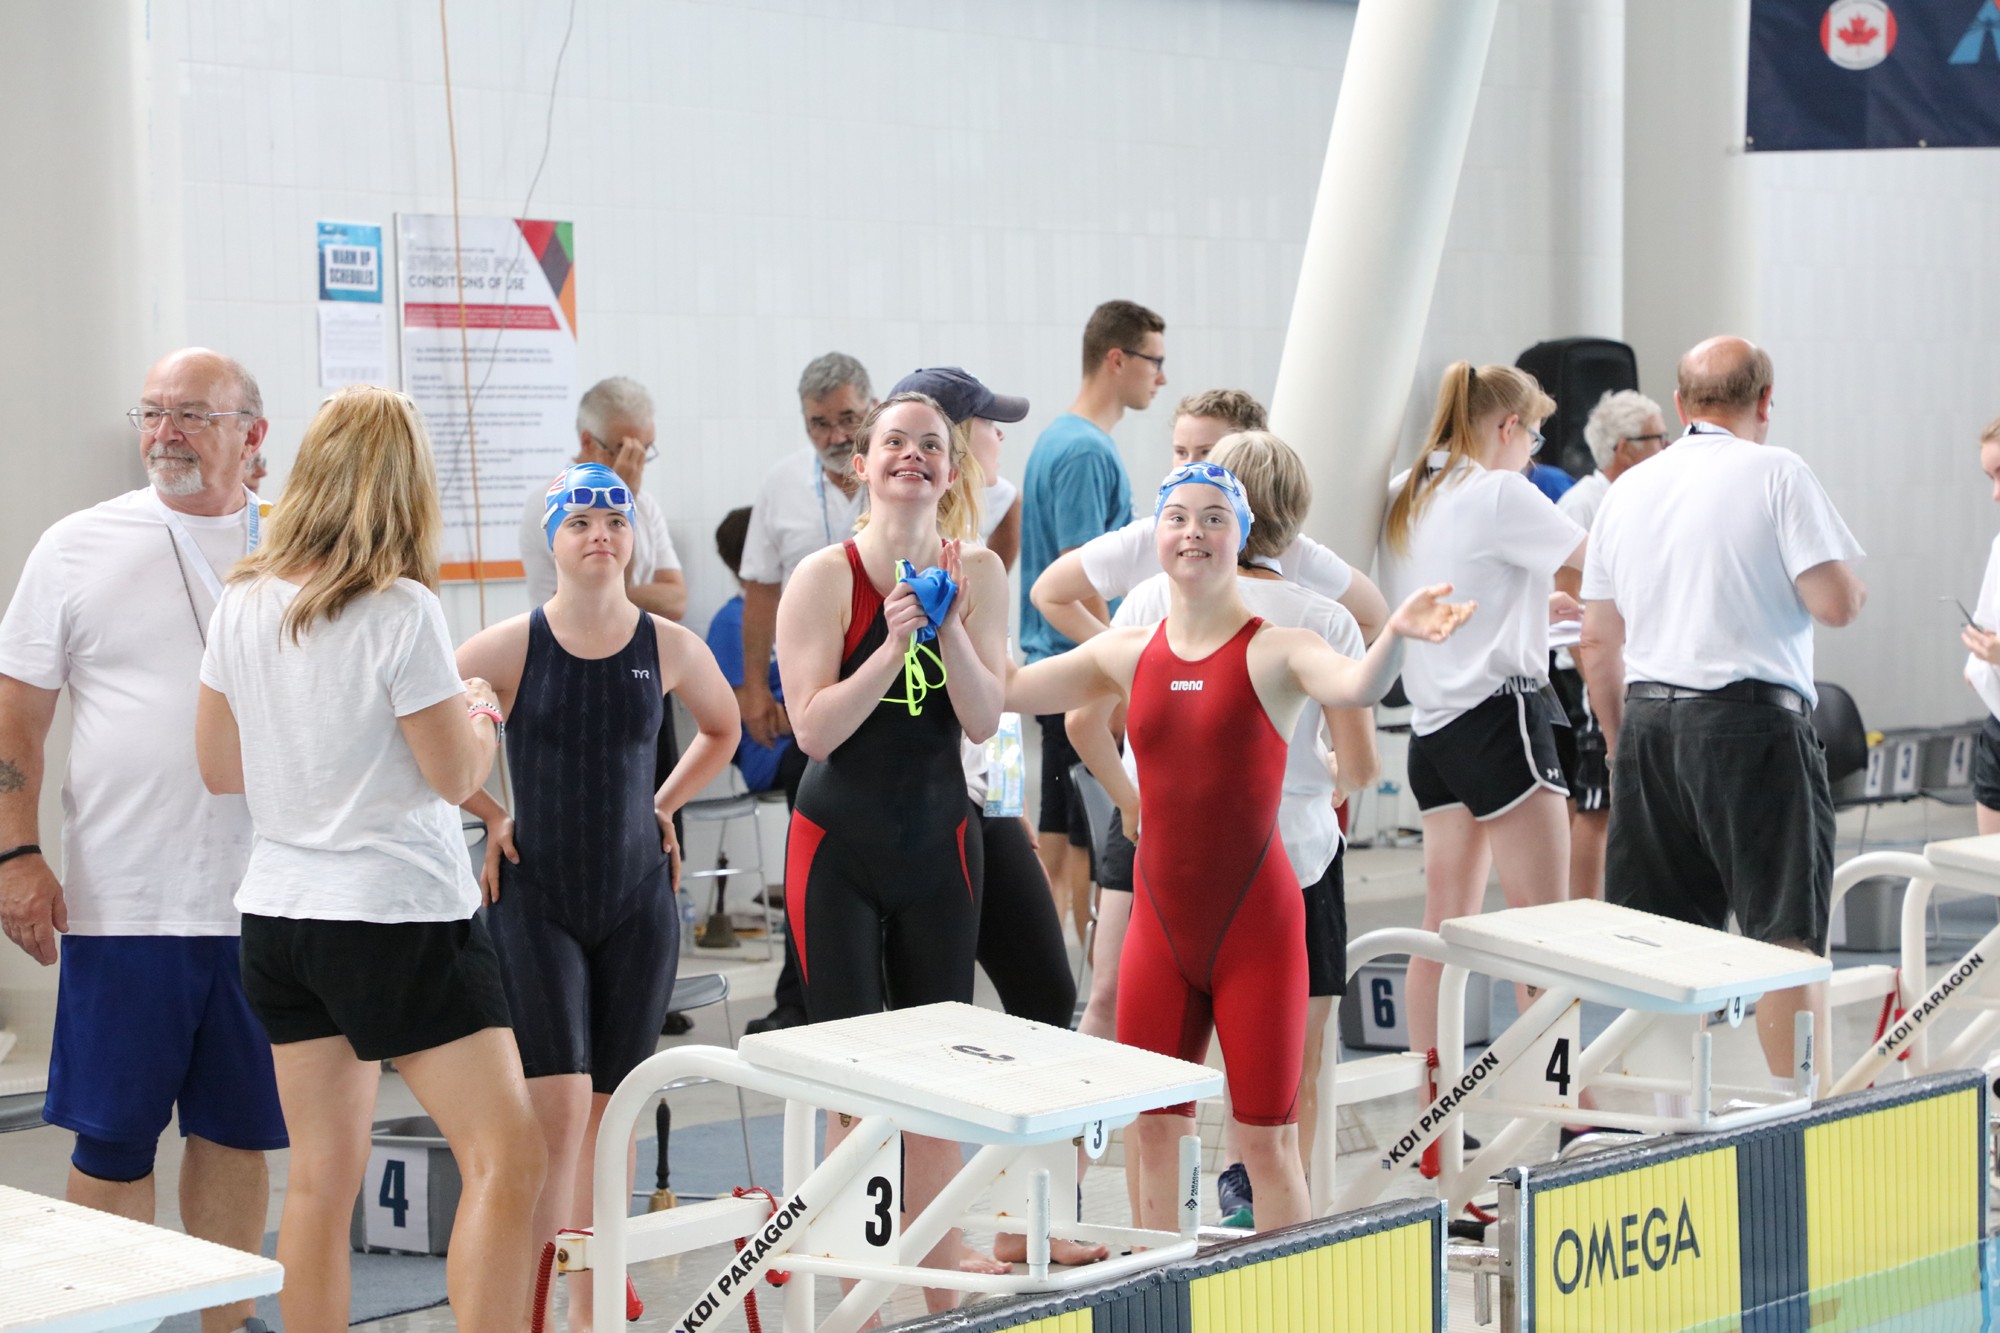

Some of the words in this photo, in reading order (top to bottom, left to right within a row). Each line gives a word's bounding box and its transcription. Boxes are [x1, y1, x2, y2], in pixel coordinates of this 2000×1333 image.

[332, 249, 357, 265] WARM
[360, 250, 371, 266] UP
[488, 277, 502, 290] OF
[631, 669, 650, 680] TYR
[1170, 680, 1204, 691] arena
[1371, 977, 1396, 1029] 6
[1733, 996, 1741, 1019] 4
[1884, 1021, 1913, 1050] KDI
[1912, 952, 1984, 1023] PARAGON
[1545, 1037, 1571, 1096] 4
[1093, 1119, 1102, 1150] 3
[1388, 1129, 1421, 1164] KDI
[1420, 1051, 1500, 1132] PARAGON
[379, 1159, 409, 1228] 4
[865, 1175, 893, 1248] 3
[682, 1291, 721, 1333] KDI
[717, 1194, 808, 1296] PARAGON
[1553, 1196, 1701, 1295] OMEGA
